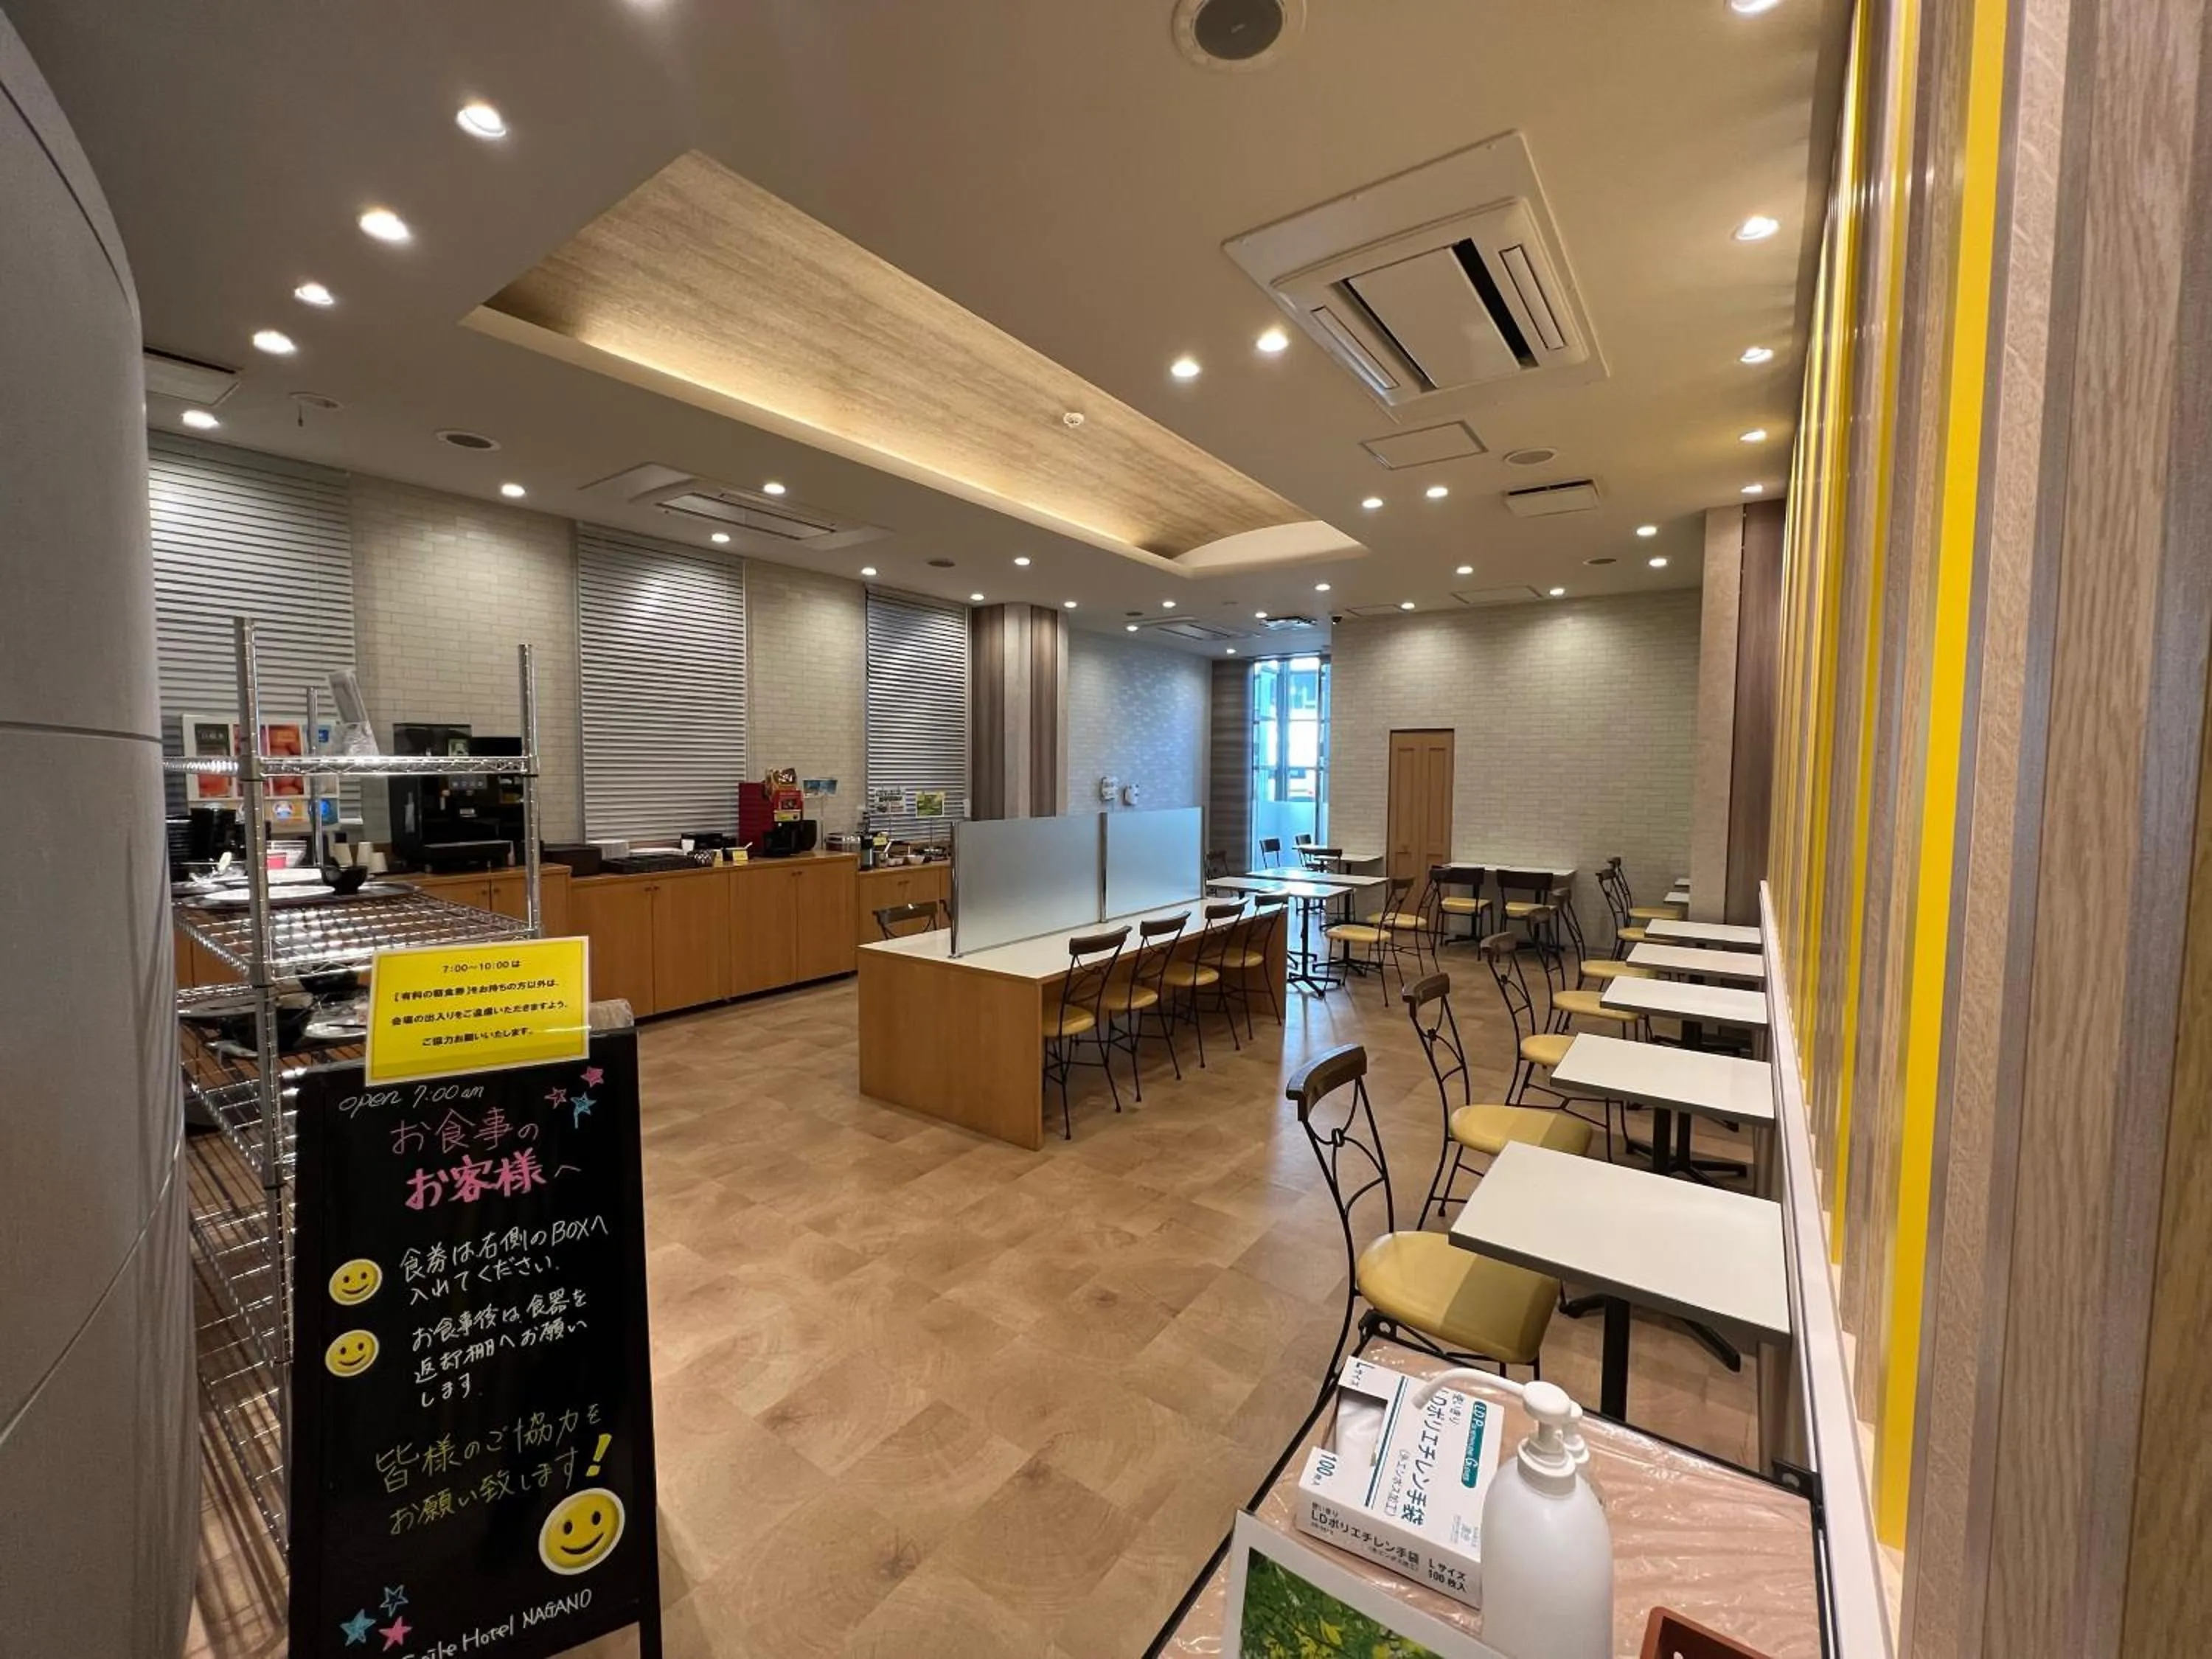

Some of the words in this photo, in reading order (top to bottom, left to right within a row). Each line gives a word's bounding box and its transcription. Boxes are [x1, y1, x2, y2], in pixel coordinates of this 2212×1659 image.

[390, 1107, 539, 1154] お食事の
[406, 1147, 581, 1210] お客様へ
[414, 1317, 588, 1383] 返却棚へお願い
[375, 1402, 602, 1494] 皆様のご協力を
[462, 1614, 514, 1652] Hotel
[523, 1588, 592, 1629] NAGANO
